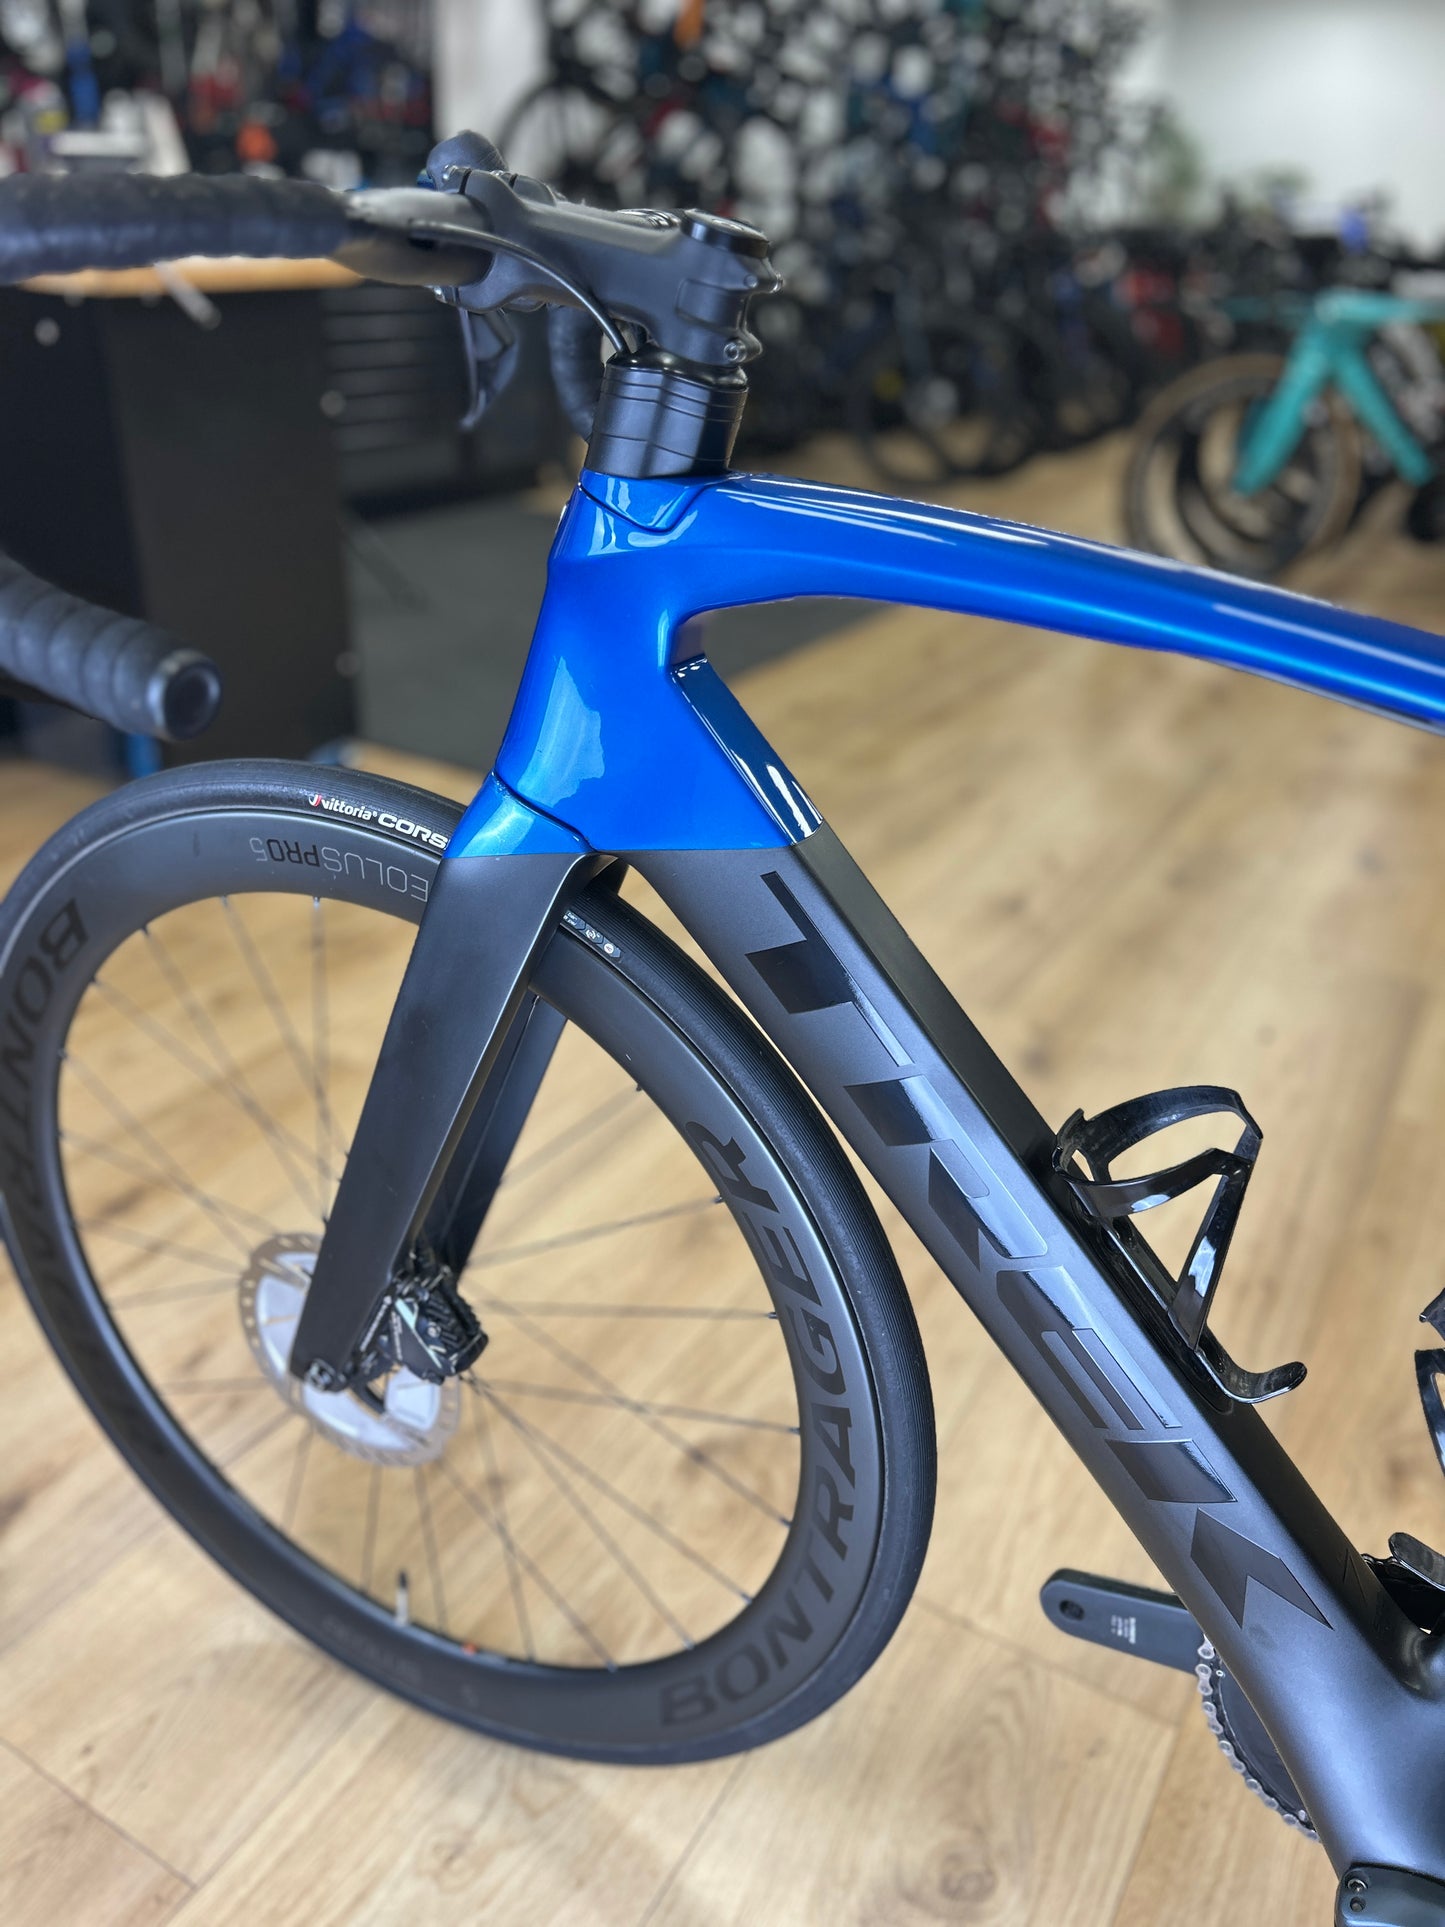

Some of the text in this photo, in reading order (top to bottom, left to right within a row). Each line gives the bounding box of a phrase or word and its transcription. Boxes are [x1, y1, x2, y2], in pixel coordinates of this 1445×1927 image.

[377, 812, 450, 851] CORS
[659, 1120, 856, 1727] BONTRAGER
[744, 870, 1331, 1631] TREK
